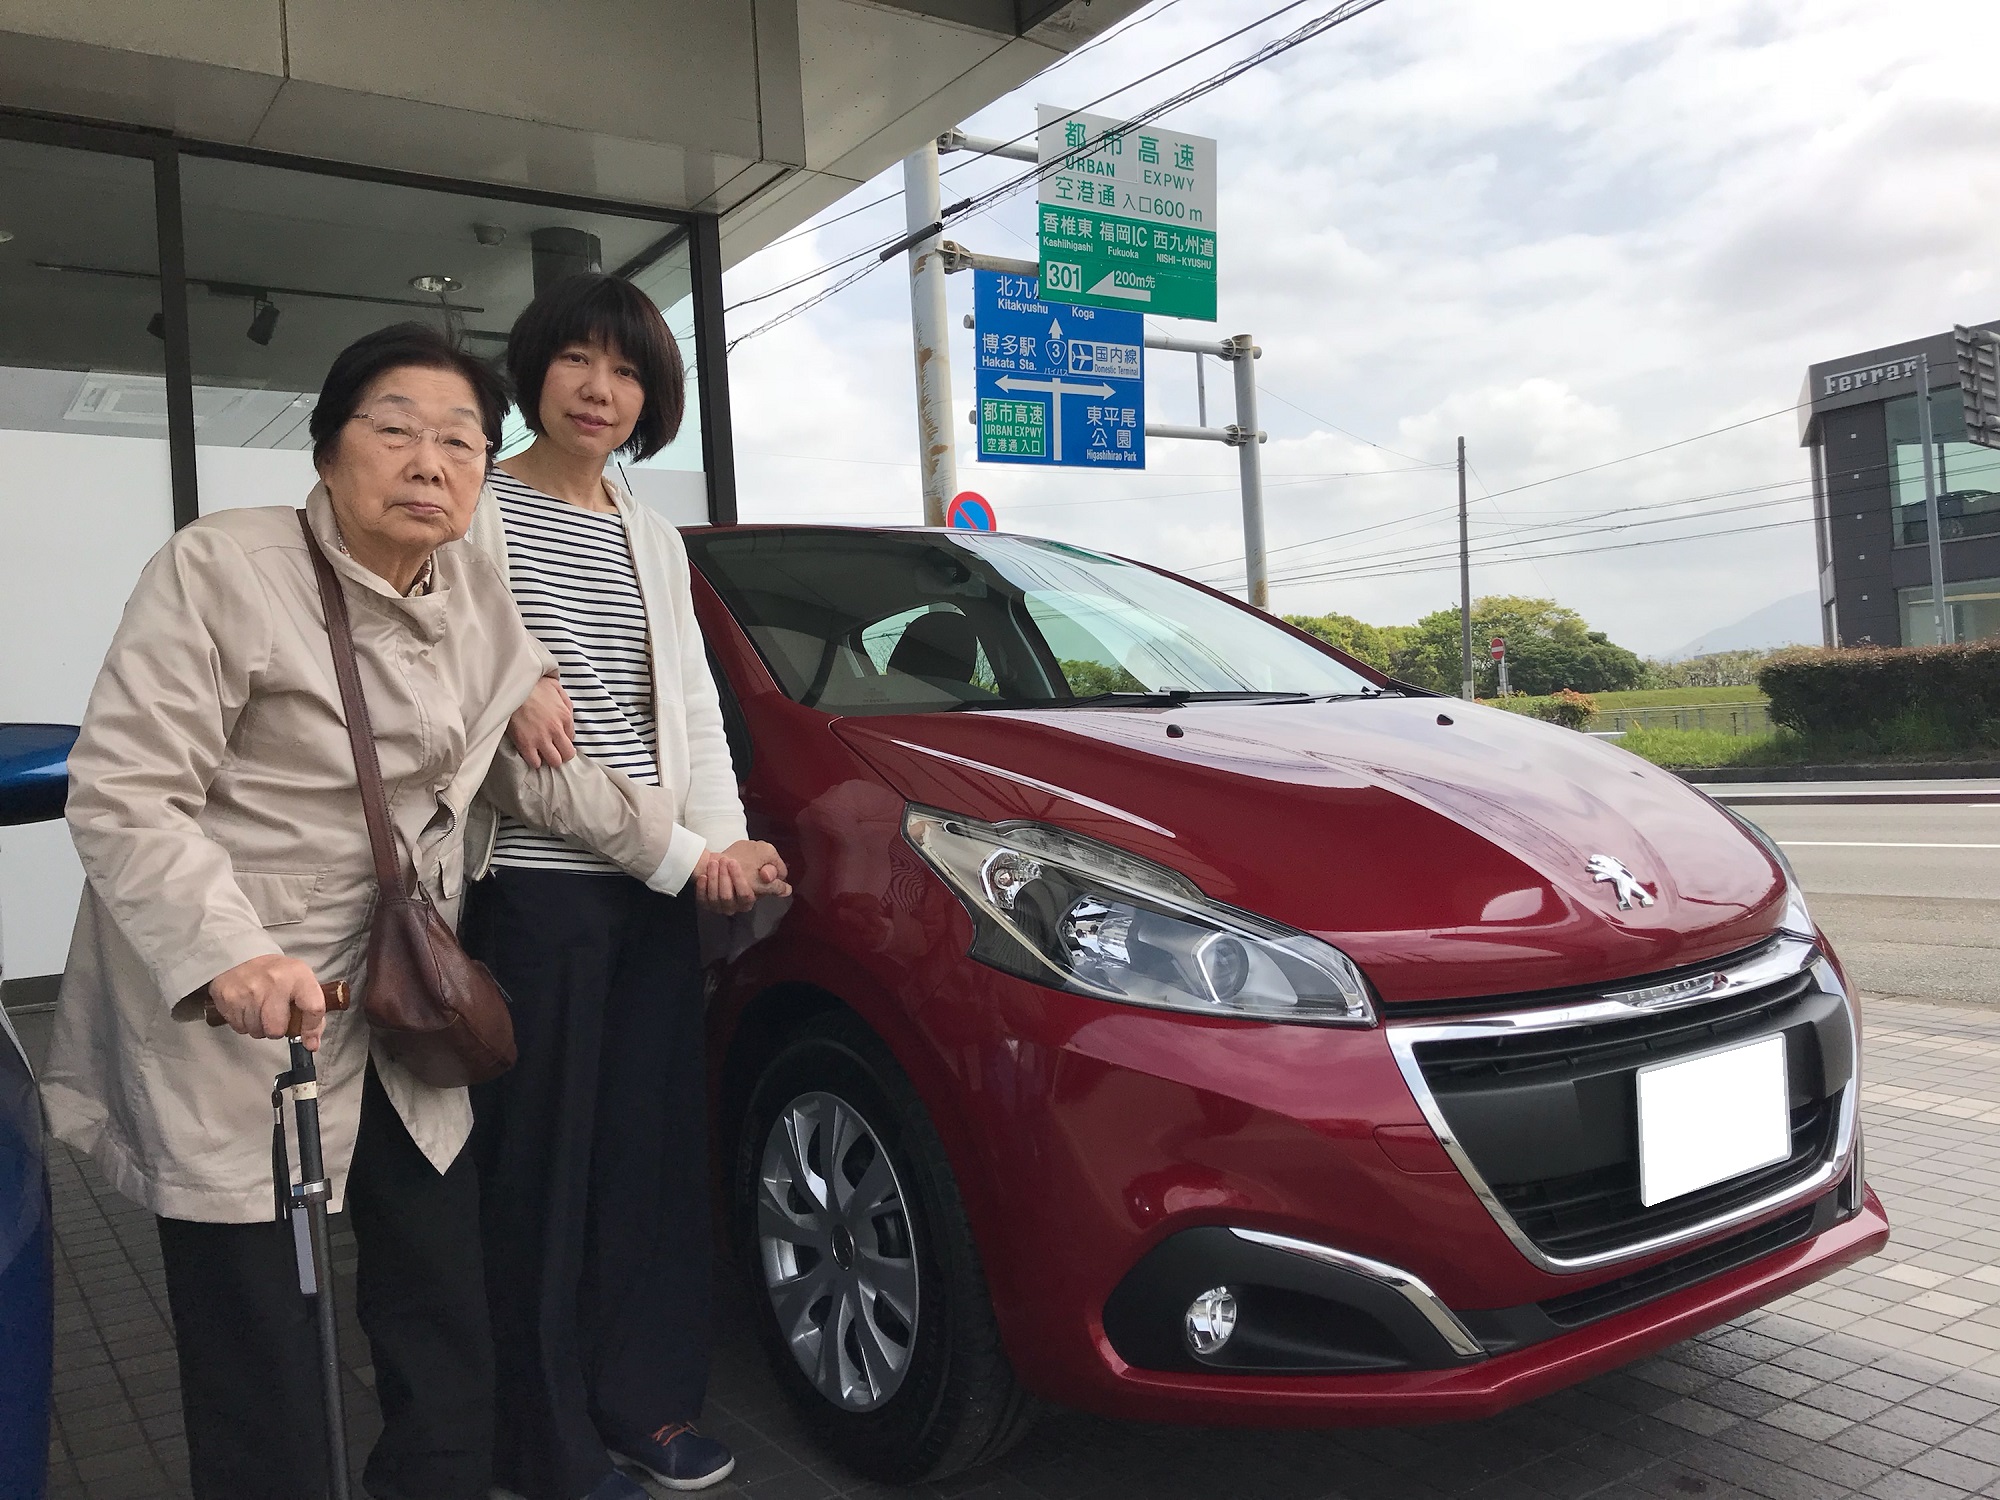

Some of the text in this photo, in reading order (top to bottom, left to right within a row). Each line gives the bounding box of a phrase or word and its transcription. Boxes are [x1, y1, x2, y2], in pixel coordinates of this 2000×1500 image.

[1065, 155, 1195, 192] URBAN EXPWY
[1055, 175, 1116, 208] 空港通
[1042, 212, 1093, 239] 香椎東
[1153, 229, 1215, 258] 西九州道
[1107, 245, 1139, 260] Fukuoka
[1049, 263, 1156, 291] 301 200m先
[997, 298, 1095, 321] Kitakyushu Koga
[982, 332, 1037, 358] 博多駅
[1052, 343, 1060, 358] 3
[1095, 346, 1138, 365] 国内線
[982, 355, 1037, 371] Hakata Sta.
[1094, 364, 1139, 376] Domestic Terminal
[983, 402, 1043, 425] 都市高速
[1086, 405, 1137, 428] 東平尾
[984, 424, 1043, 438] URBAN EXPWY
[1091, 427, 1132, 449] 公園
[986, 437, 1040, 454] 空港通 入口
[1086, 449, 1137, 462] Higashihirao Park
